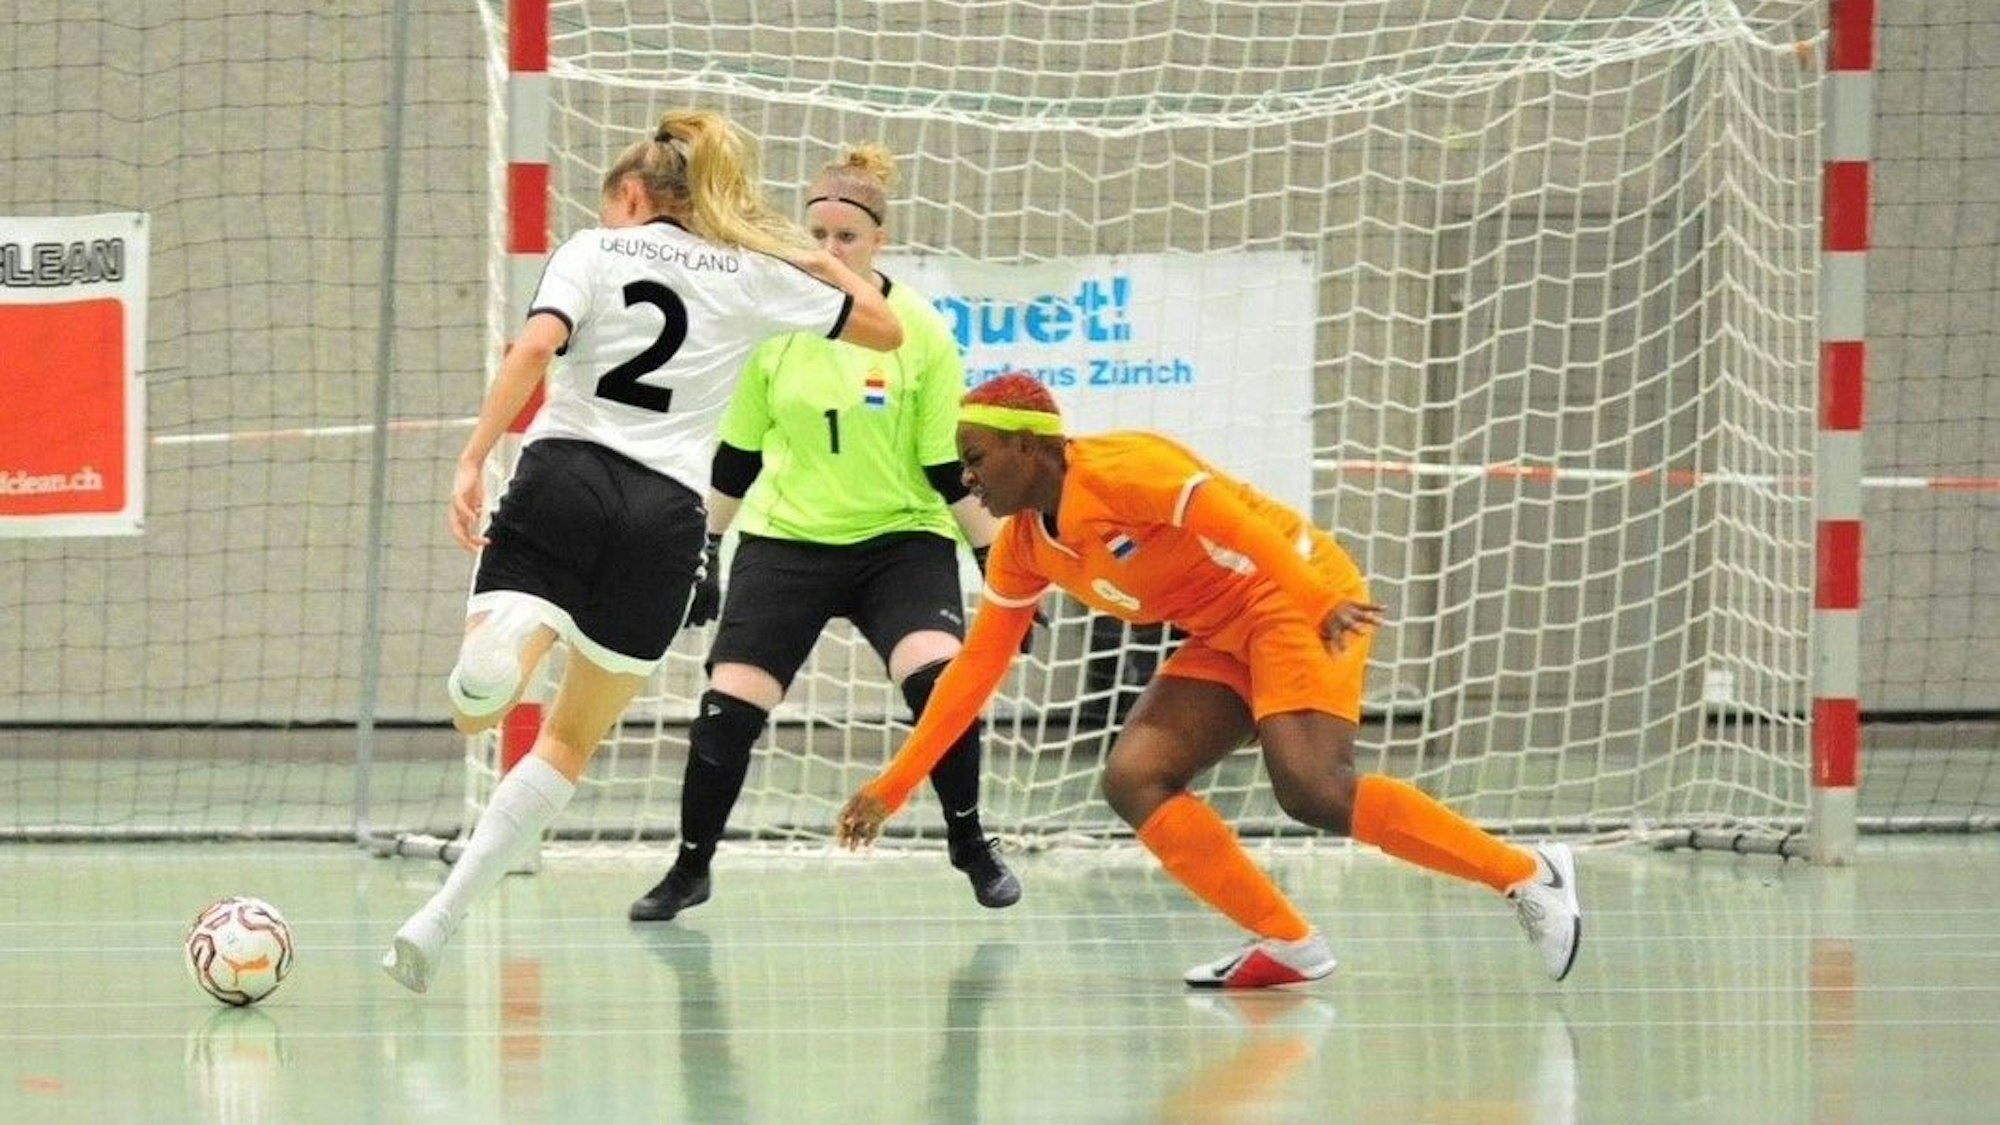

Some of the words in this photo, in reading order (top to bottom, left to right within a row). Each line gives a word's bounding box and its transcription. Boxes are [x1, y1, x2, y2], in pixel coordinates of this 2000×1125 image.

[0, 237, 124, 288] LEAN
[600, 238, 739, 273] DEUTSCHLAND
[595, 279, 688, 414] 2
[1089, 358, 1192, 385] Zürich
[824, 408, 840, 454] 1
